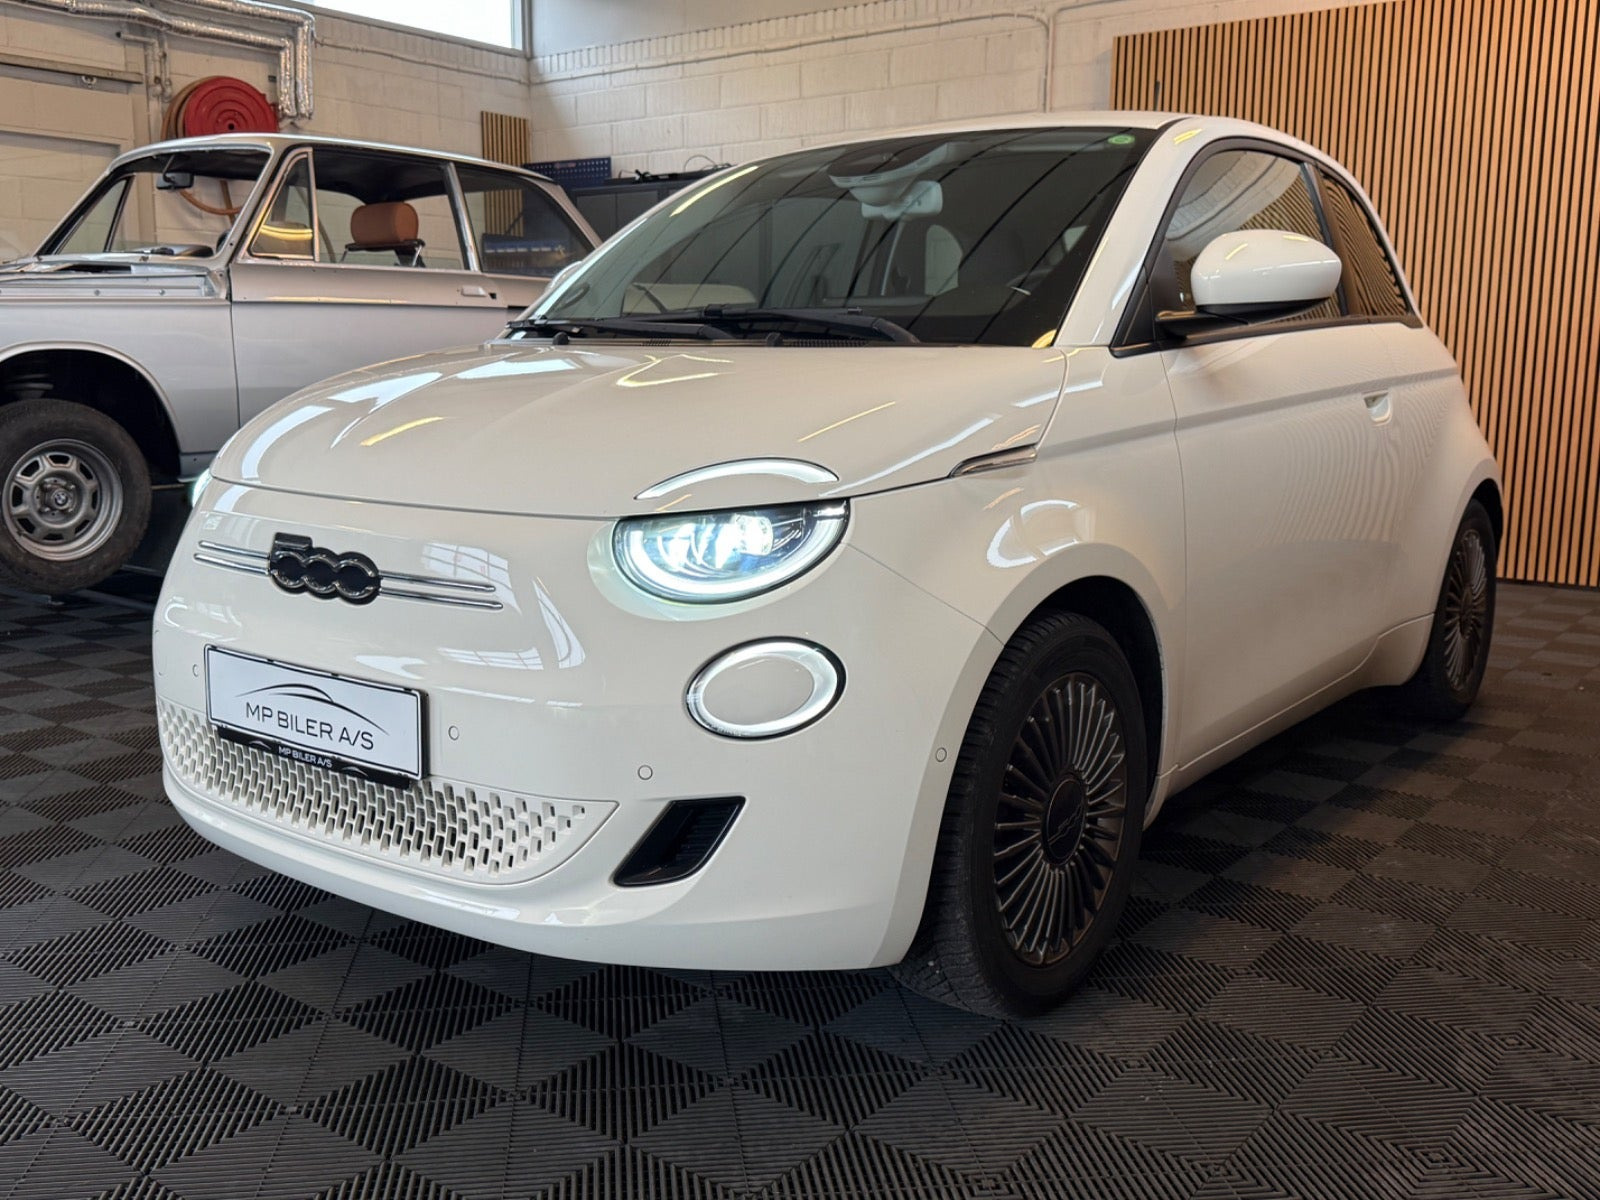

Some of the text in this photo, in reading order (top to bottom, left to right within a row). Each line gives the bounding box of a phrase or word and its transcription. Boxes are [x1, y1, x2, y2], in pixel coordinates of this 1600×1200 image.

[246, 702, 374, 750] MP BILER A/S
[278, 745, 333, 768] MP BILER A/S
